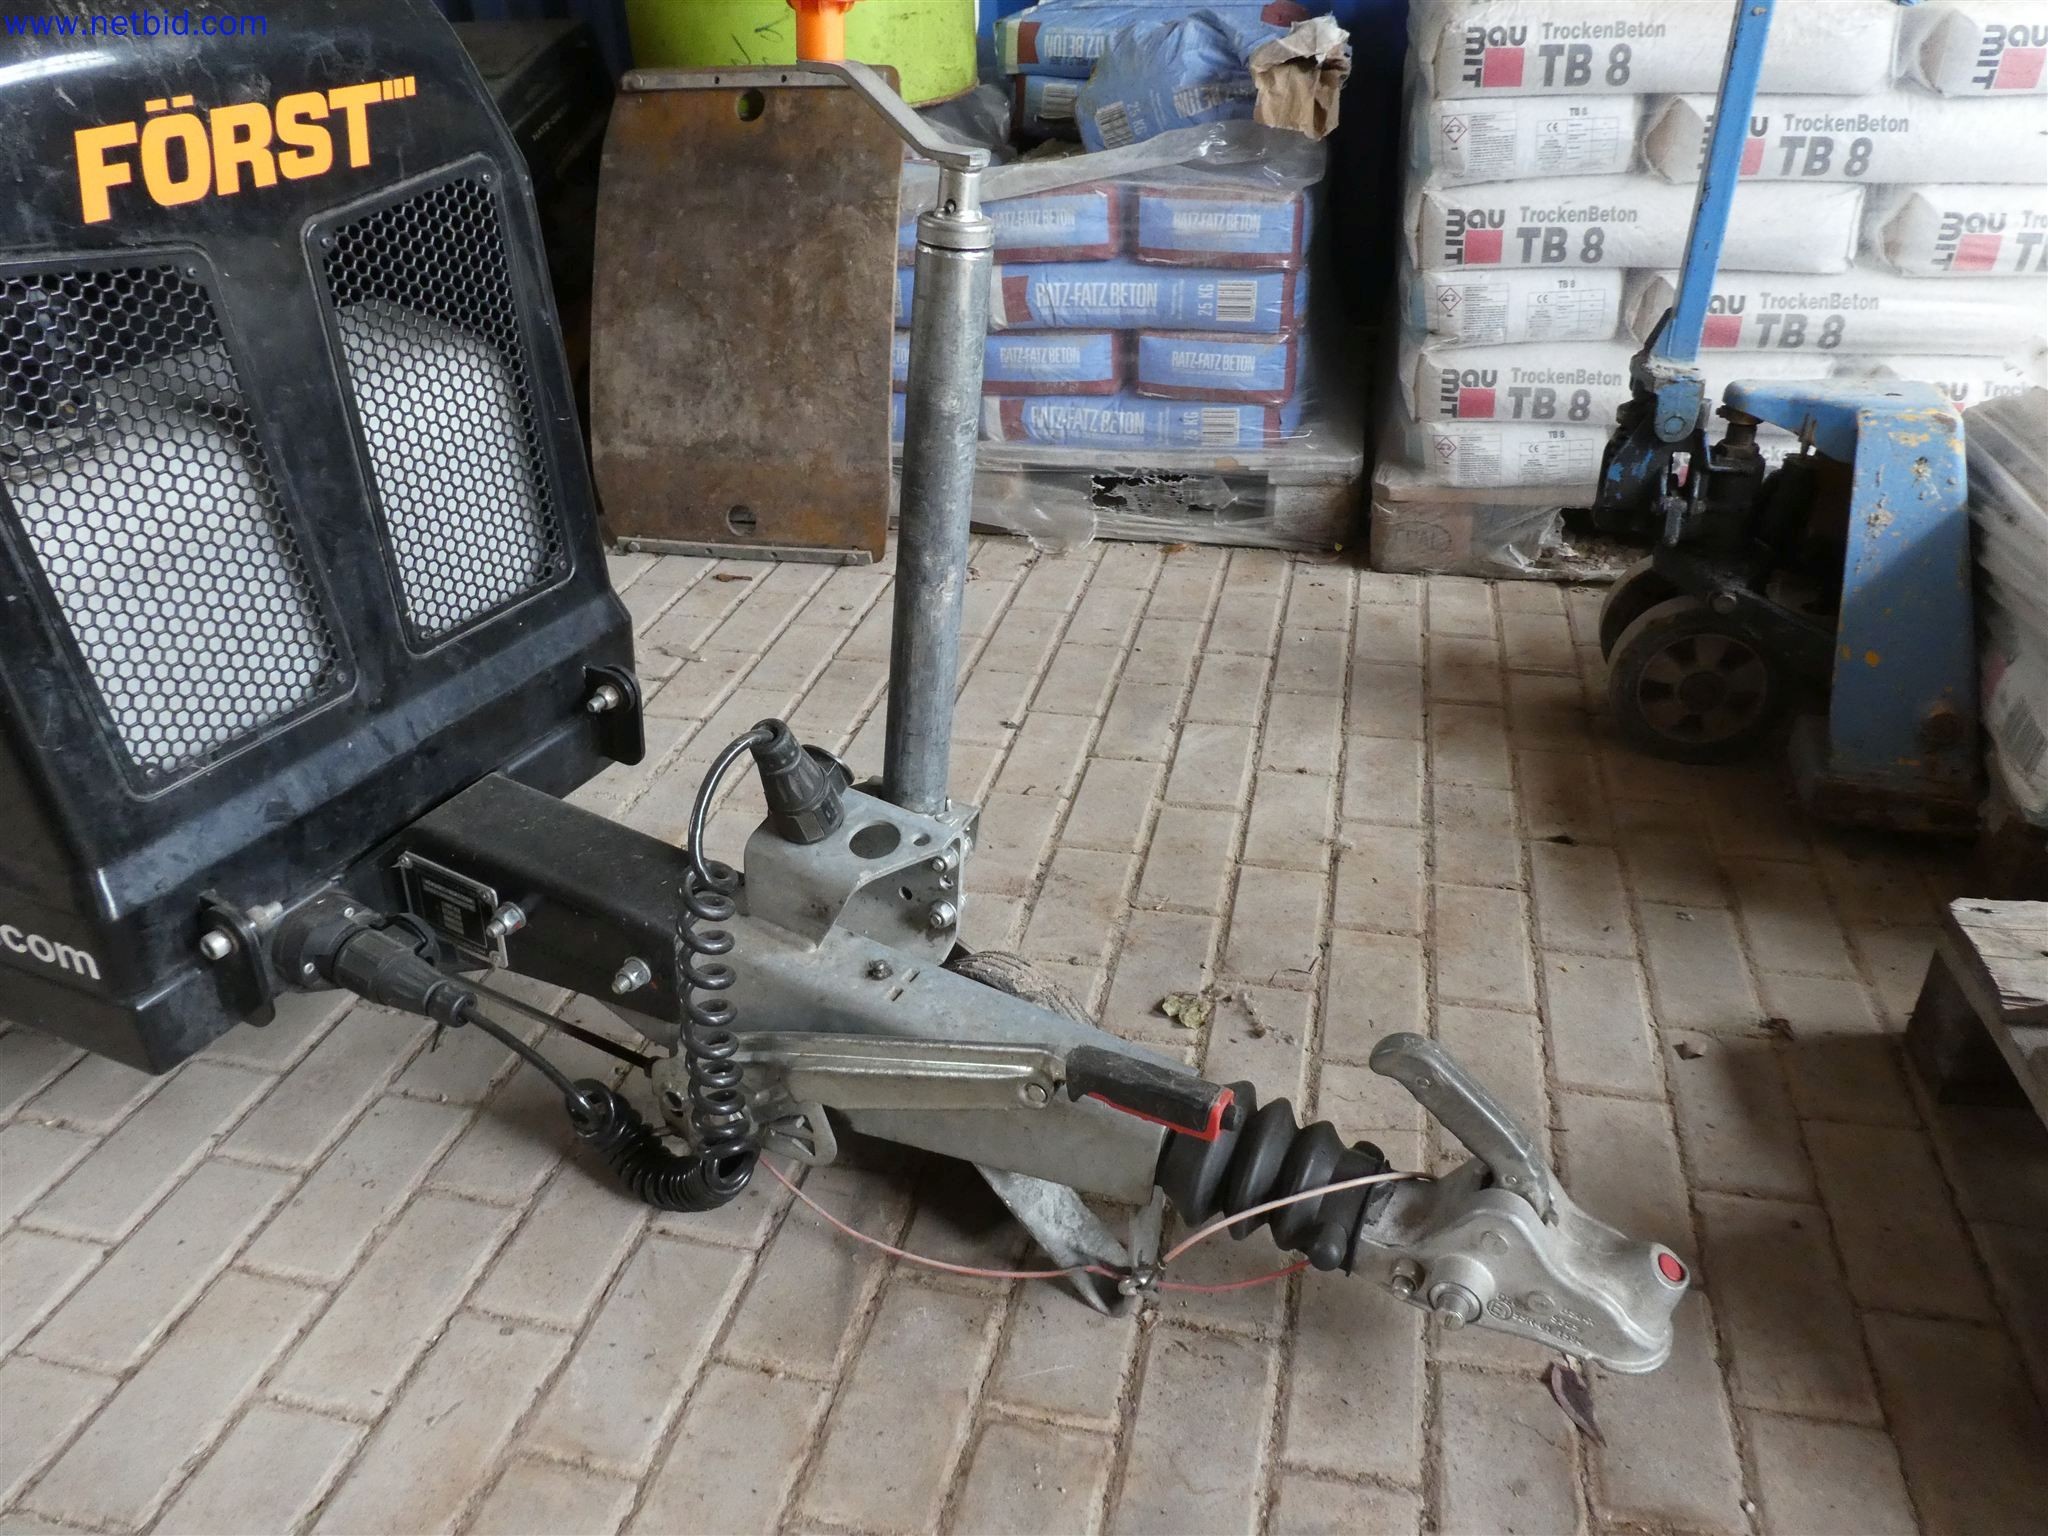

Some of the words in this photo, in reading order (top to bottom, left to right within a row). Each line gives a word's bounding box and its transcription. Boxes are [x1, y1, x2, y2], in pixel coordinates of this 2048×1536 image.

[1542, 20, 1666, 40] TrockenBeton
[1538, 43, 1593, 87] TB
[1605, 43, 1632, 87] 8
[1783, 113, 1909, 133] TrockenBeton
[74, 82, 384, 225] FÖRST
[1779, 136, 1833, 177] TB
[1843, 136, 1873, 177] 8
[1520, 205, 1637, 223] TrockenBeton
[1516, 227, 1568, 264] TB
[1579, 226, 1605, 264] 8
[1035, 282, 1109, 308] RATZ-FATZ
[1111, 281, 1157, 308] BETON
[1197, 284, 1214, 298] KG
[1759, 291, 1879, 310] TrockenBeton
[1197, 302, 1214, 317] 25
[1755, 313, 1808, 349] TB
[1817, 314, 1846, 349] 8
[1049, 347, 1080, 364] BETON
[1223, 353, 1255, 372] BETON
[1511, 367, 1622, 386] TrockenBeton
[1508, 387, 1556, 419] TB
[1568, 388, 1592, 421] 8
[1100, 409, 1145, 435] BETON
